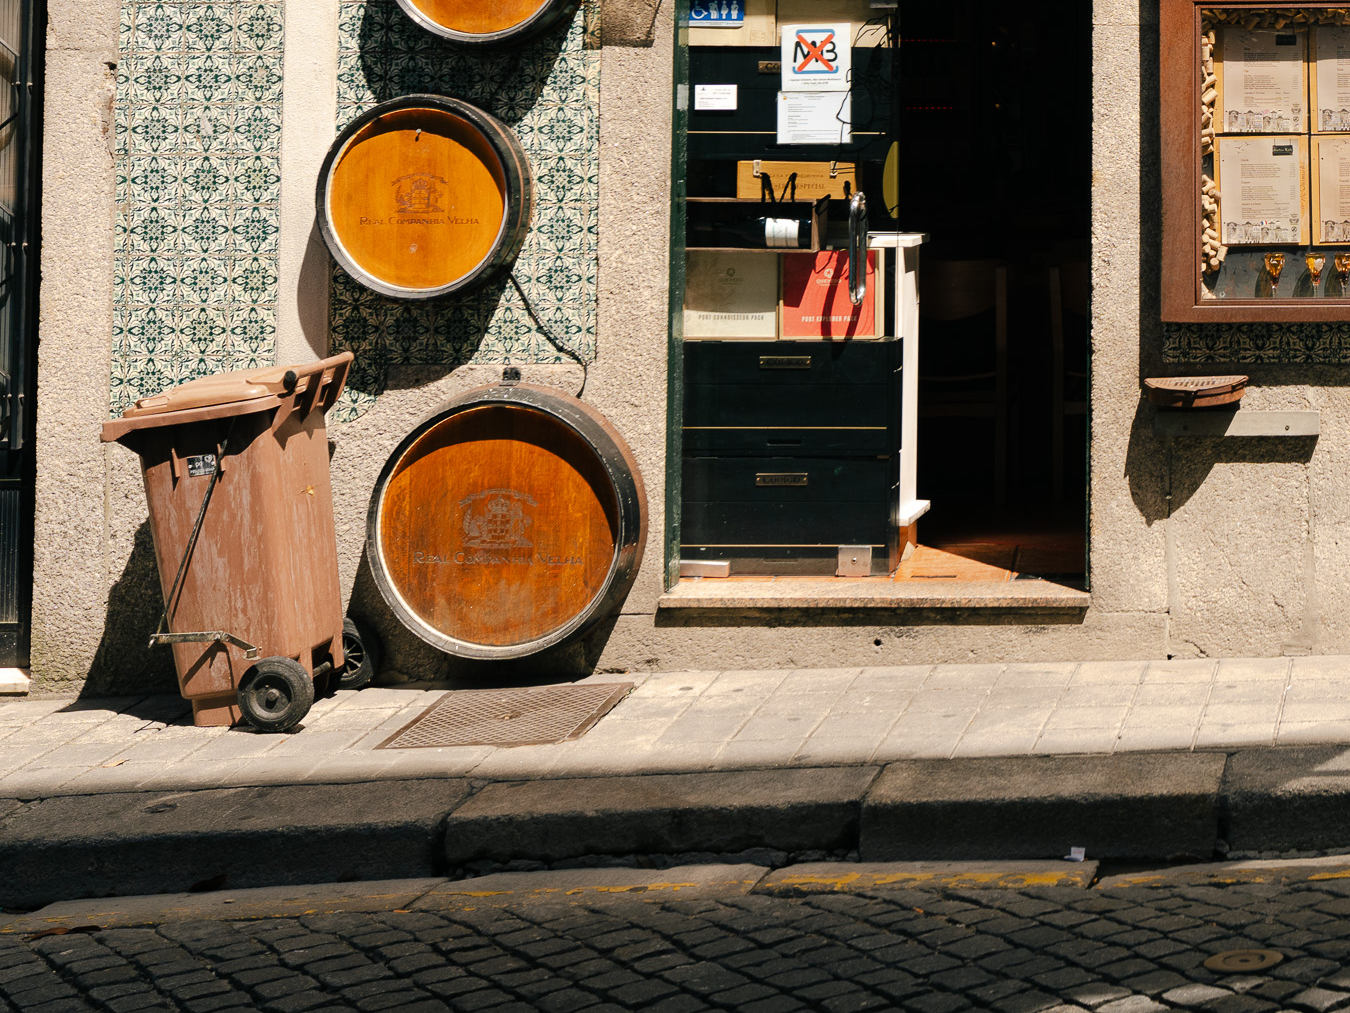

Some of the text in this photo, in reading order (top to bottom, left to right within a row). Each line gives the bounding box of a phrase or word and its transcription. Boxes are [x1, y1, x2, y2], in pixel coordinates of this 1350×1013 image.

[360, 216, 479, 226] REAL COMPANHIA VELHA
[412, 550, 584, 566] REAL COMPANHIA VELHA
